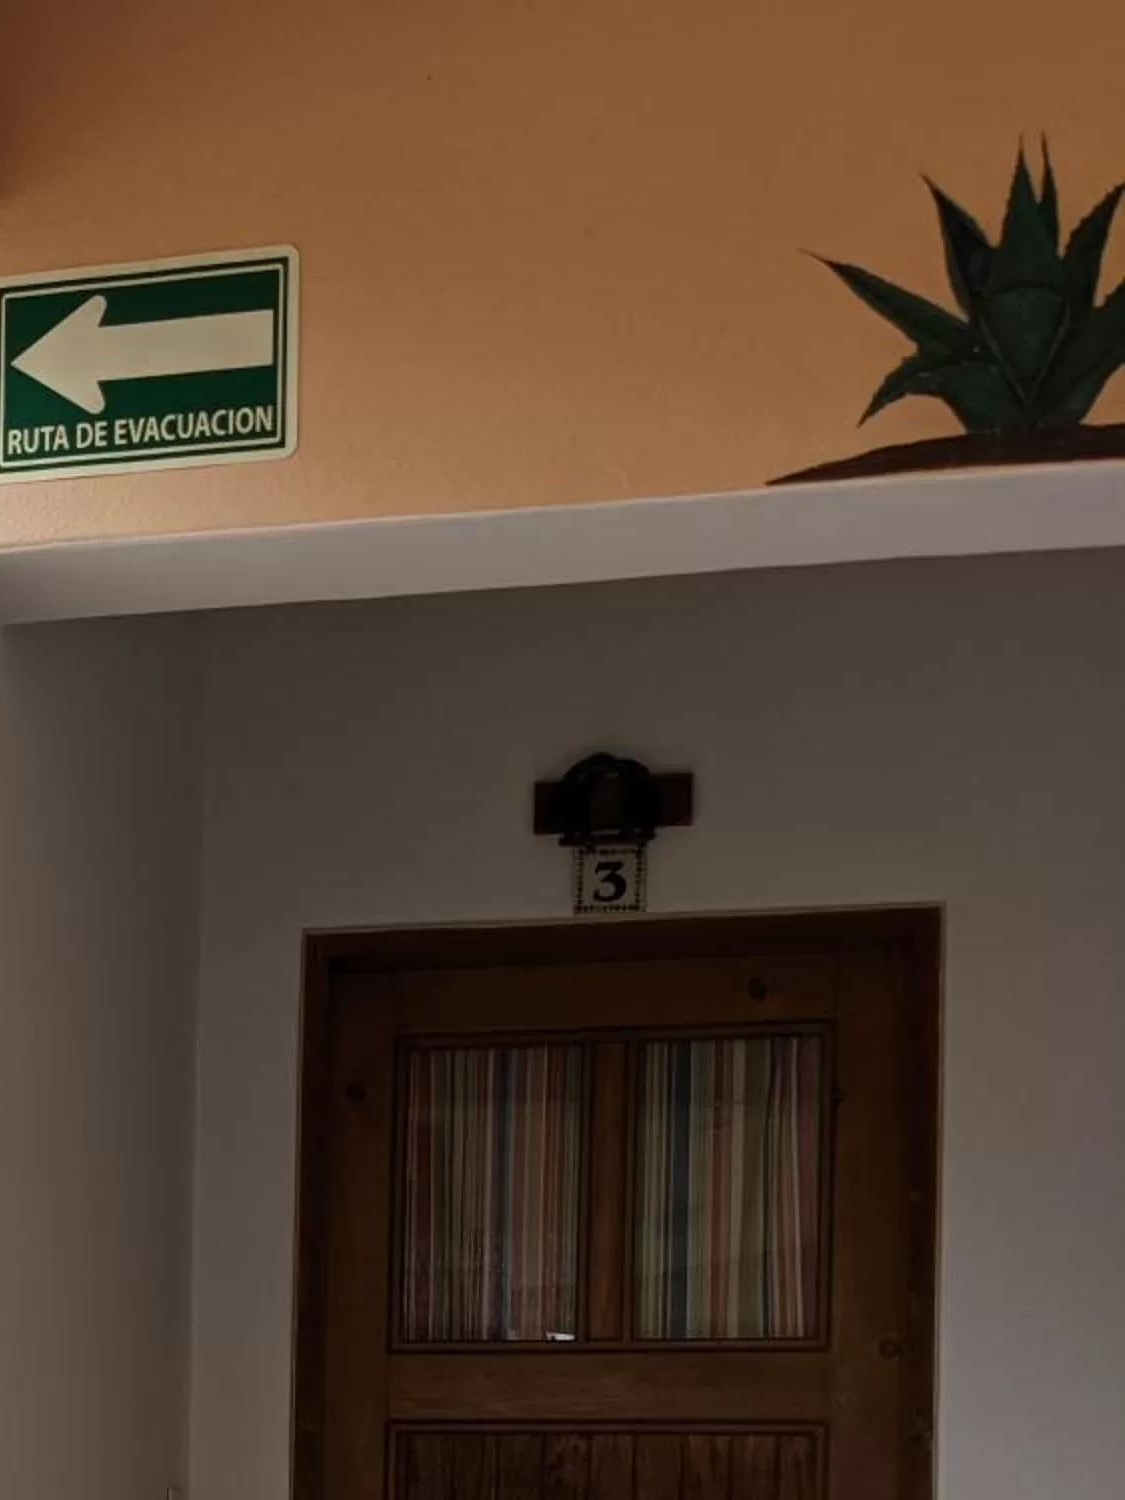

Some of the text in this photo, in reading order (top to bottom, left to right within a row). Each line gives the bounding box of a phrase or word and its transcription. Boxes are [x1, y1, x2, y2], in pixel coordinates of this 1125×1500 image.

[7, 405, 273, 455] RUTA DE EVACUACION
[593, 861, 627, 902] 3
